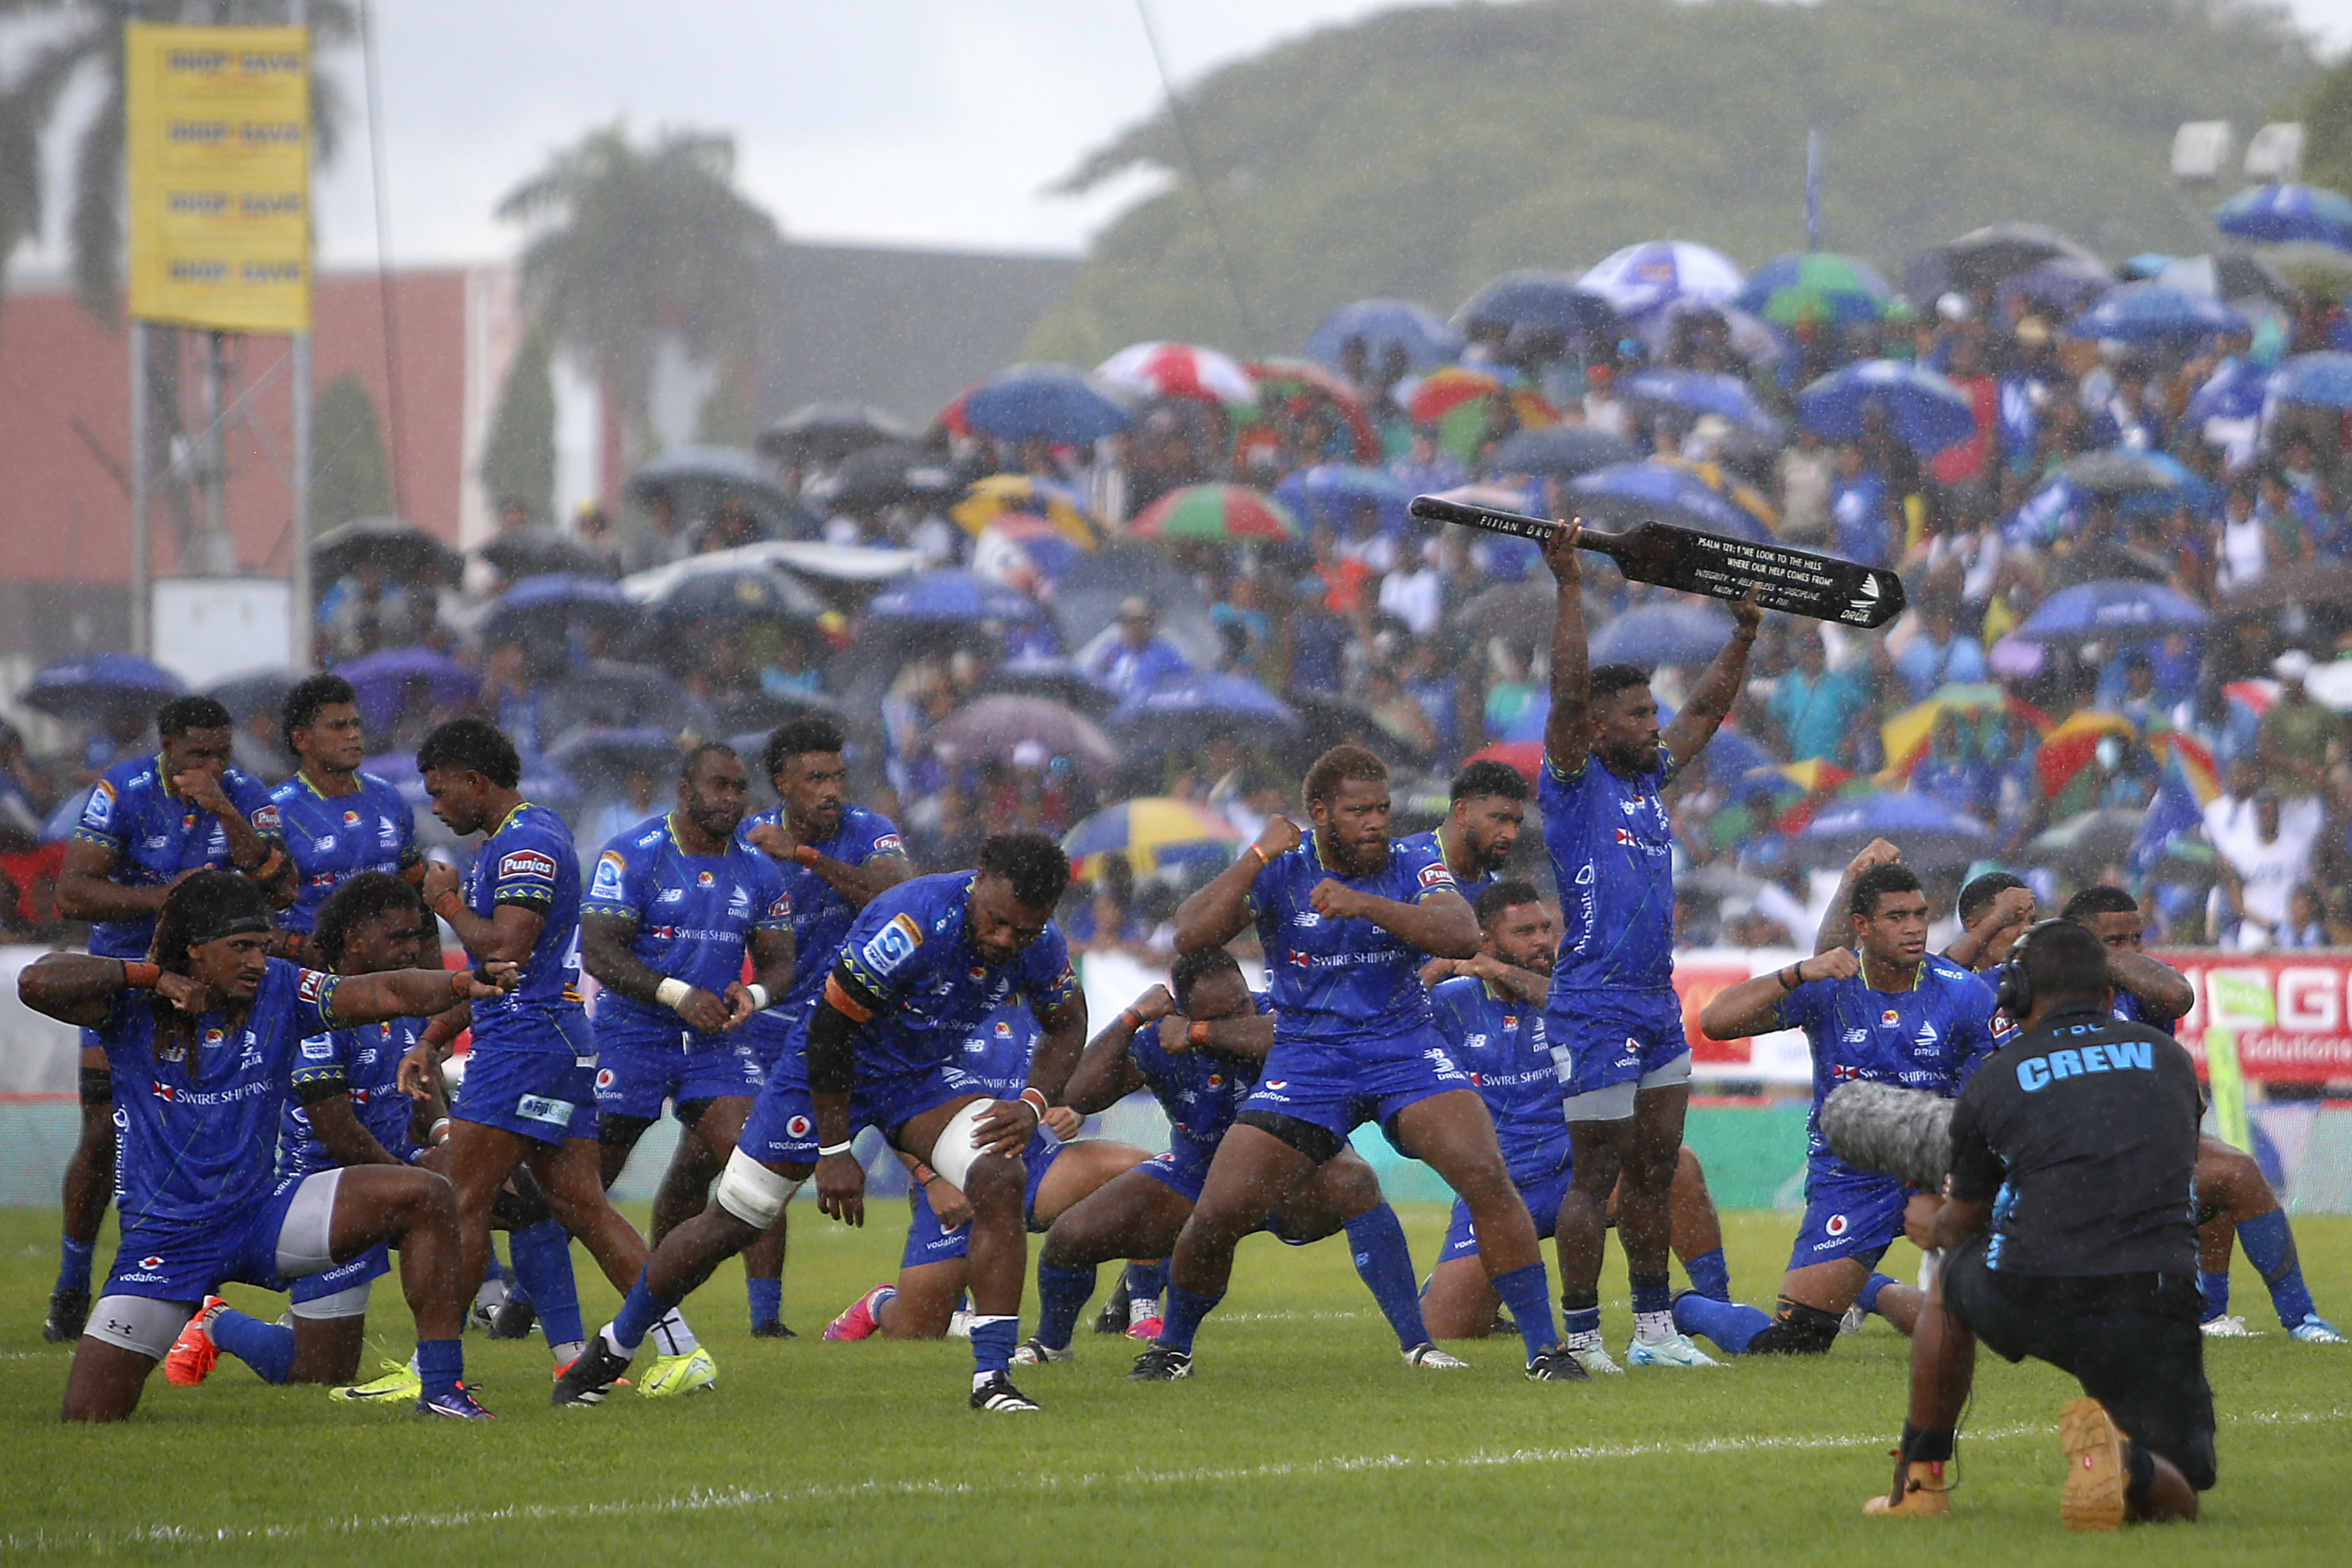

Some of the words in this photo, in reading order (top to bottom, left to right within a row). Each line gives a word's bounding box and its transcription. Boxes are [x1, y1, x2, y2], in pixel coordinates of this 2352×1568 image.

[1480, 515, 1519, 532] FIJIAN
[1526, 525, 1552, 538] DRU
[1698, 537, 1719, 550] PSALM
[1756, 549, 1774, 561] LOOK
[1777, 554, 1787, 563] TO
[1789, 556, 1802, 567] THE
[1804, 560, 1822, 571] HILLS
[1695, 568, 1729, 582] INTEGRITY
[1727, 557, 1750, 570] WHERE
[1751, 562, 1766, 573] OUR
[1769, 566, 1785, 576] HELP
[1787, 570, 1810, 583] COMES
[1712, 584, 1733, 595] FAITH
[1839, 609, 1870, 623] DRUA
[503, 858, 552, 874] Punjas
[674, 927, 707, 940] SWIRE
[1311, 954, 1351, 966] SWIRE
[1914, 1048, 1941, 1057] DRUA
[2016, 1041, 2153, 1092] CREW
[1482, 1075, 1519, 1087] SWIRE
[176, 1089, 218, 1106] SWIRE
[322, 1260, 366, 1281] vodafone
